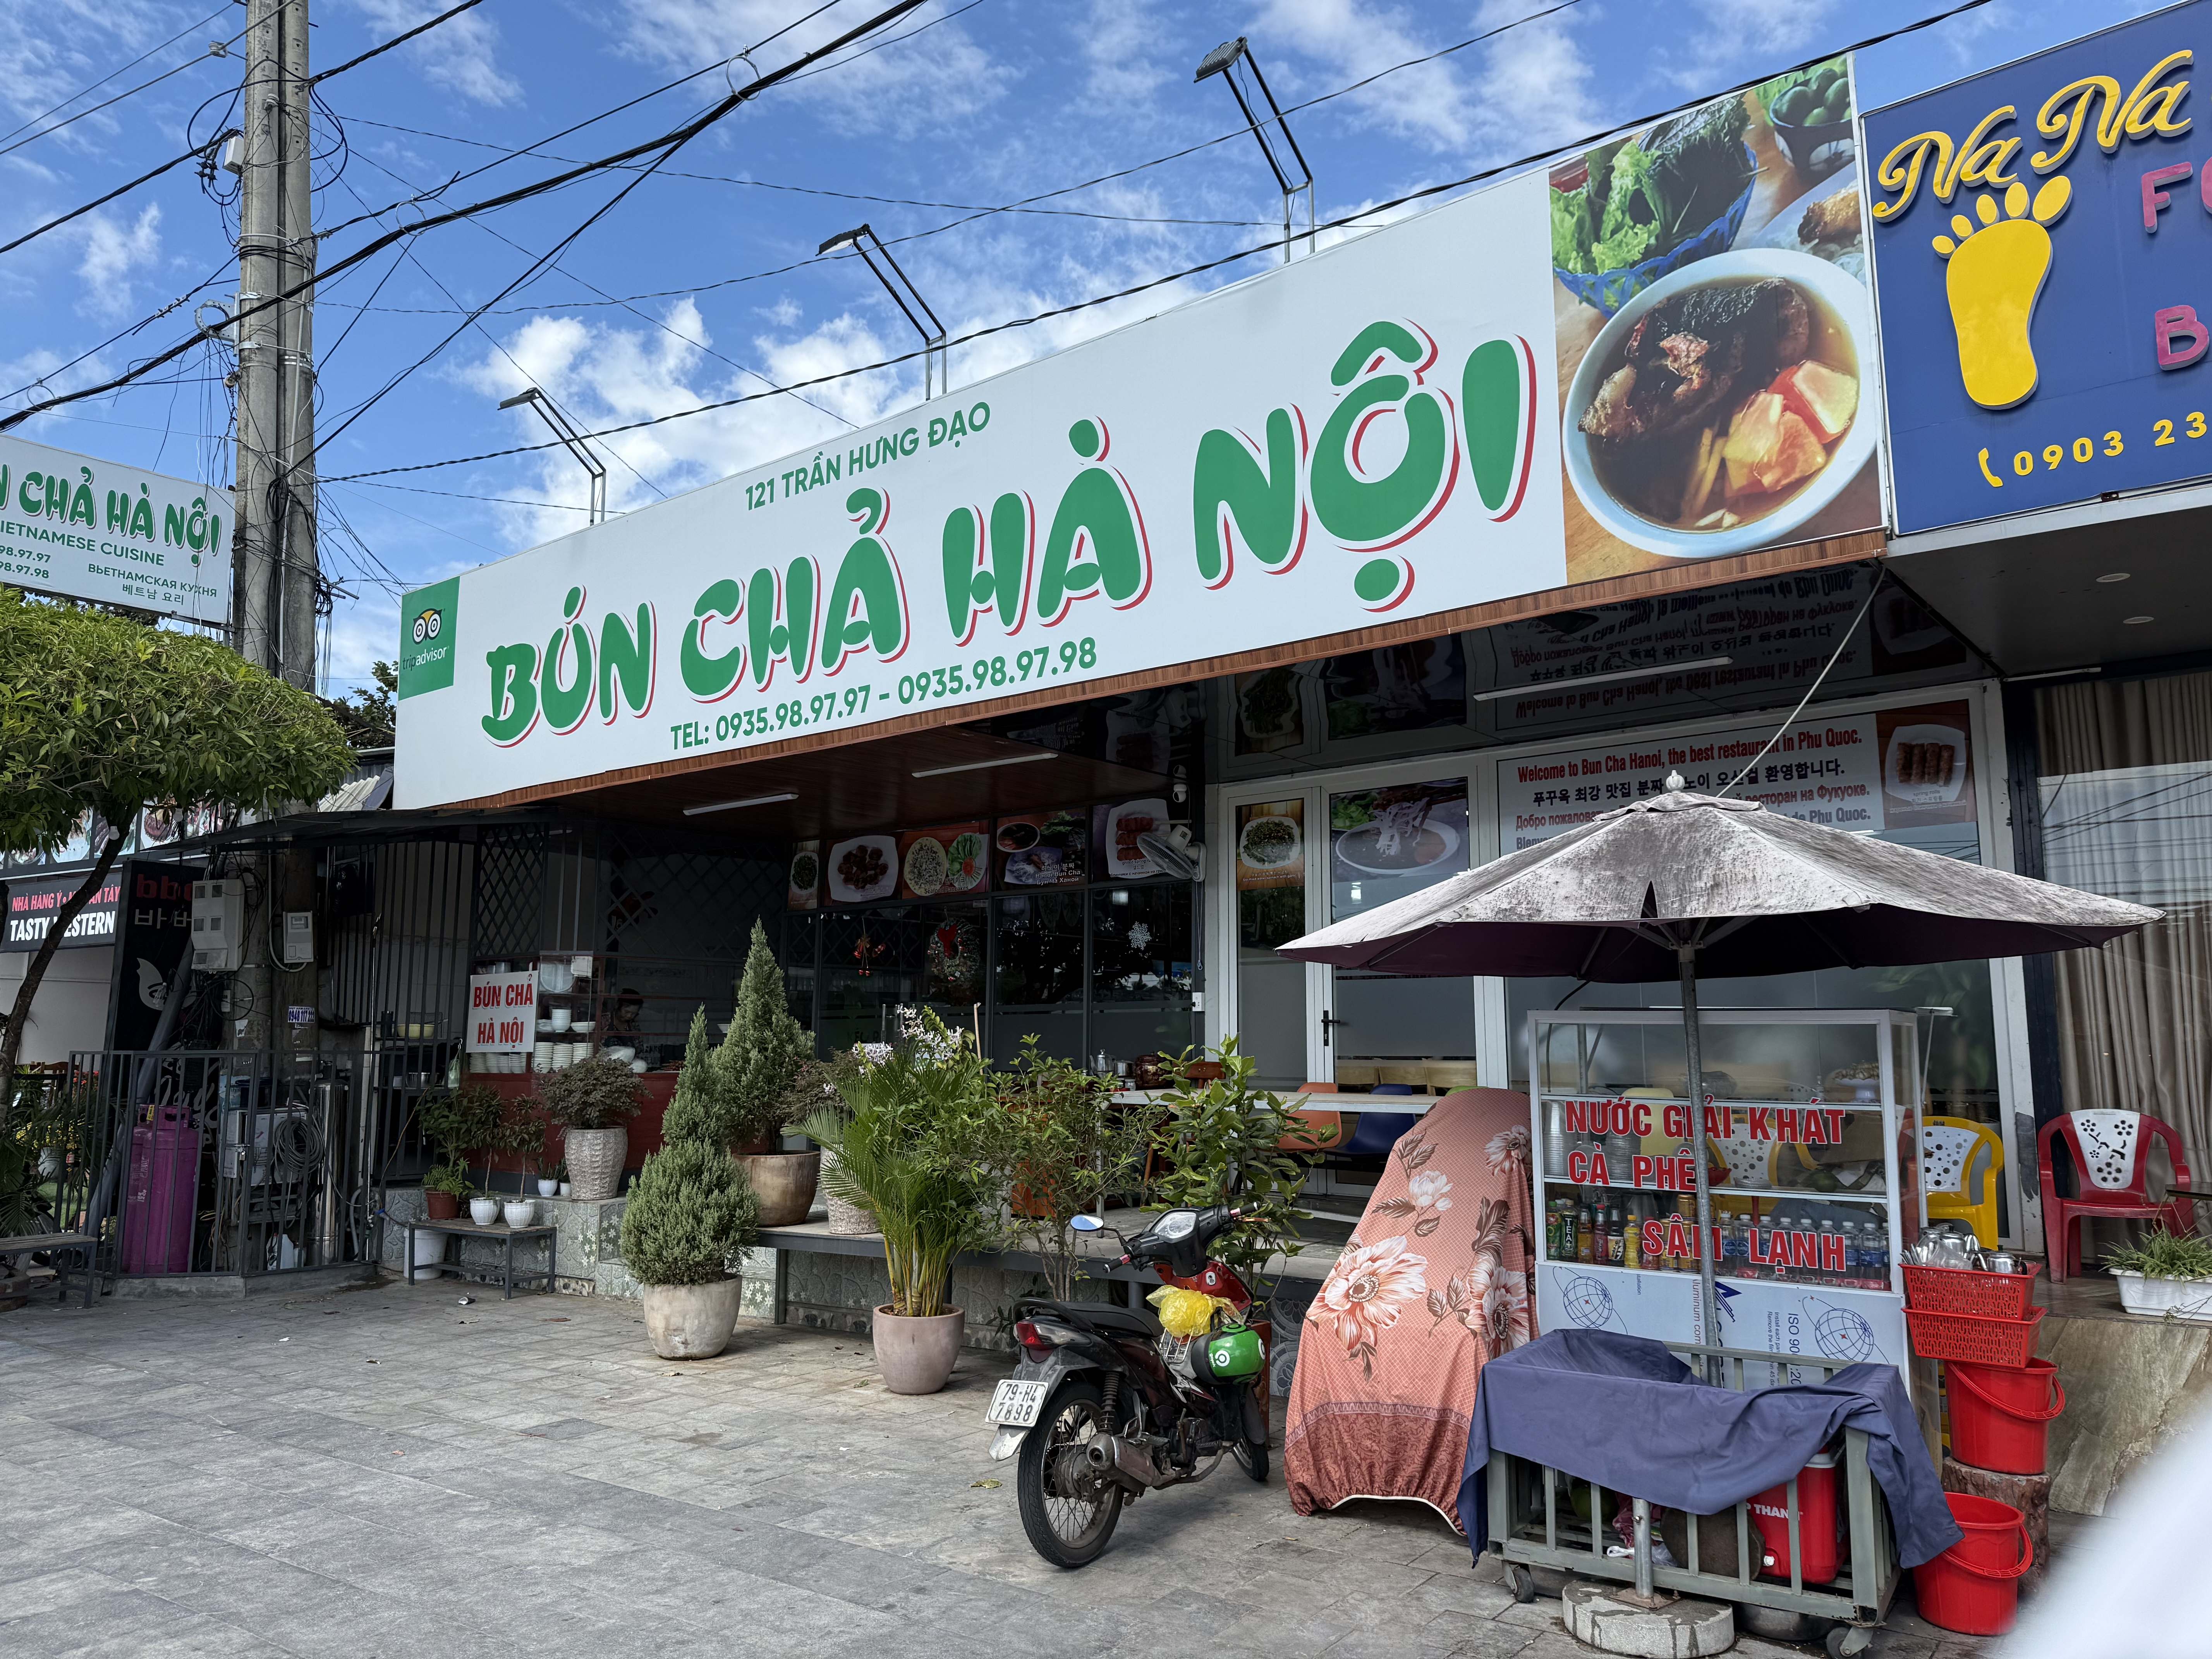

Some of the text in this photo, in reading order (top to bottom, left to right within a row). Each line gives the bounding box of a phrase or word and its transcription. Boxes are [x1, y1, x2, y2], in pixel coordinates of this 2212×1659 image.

[1873, 50, 2193, 223] Na Na
[2141, 156, 2212, 234] F
[745, 402, 990, 511] 121 TRẦN HƯNG ĐẠO
[2014, 412, 2207, 476] 0903 23
[19, 466, 96, 529] CHẢ
[107, 483, 155, 541] HÀ
[165, 497, 222, 567] NỘI
[481, 316, 1537, 748] BÚN CHẢ HÀ NỘI
[100, 542, 165, 566] CUISINE
[88, 563, 217, 597] ВЬЕТНАМСКАЯ КУХНЯ
[122, 584, 184, 605] 베트남 요리
[402, 646, 448, 671] tripadvisor
[670, 723, 709, 750] TEL:
[716, 684, 871, 742] 0935.98.97.97
[898, 637, 1097, 705] 0935.98.97.98
[1518, 764, 1566, 783] Welcome
[1568, 761, 1579, 777] to
[1582, 758, 1602, 775] Bun
[1605, 755, 1626, 773] Cha
[1630, 749, 1665, 769] Hanoi,
[1668, 748, 1686, 765] the
[1689, 743, 1715, 763] best
[1783, 734, 1795, 752] in
[1798, 731, 1822, 750] Phu
[1826, 728, 1862, 747] Quoc.
[1533, 788, 1571, 807] 푸꾸옥
[1575, 785, 1601, 802] 최강
[1606, 781, 1631, 800] 맛집
[1637, 778, 1664, 796] 분짜
[1683, 772, 1710, 790] 노이
[1765, 757, 1845, 783] 환영합니다.
[1516, 814, 1546, 831] Добро
[1801, 787, 1814, 801] на
[1817, 783, 1870, 802] Фукуоке.
[1810, 809, 1832, 823] Phu
[1836, 807, 1871, 822] Quoc.
[12, 893, 29, 912] NHÀ
[31, 891, 54, 910] HÀNG
[104, 884, 121, 903] TÂY
[10, 911, 115, 941] TASTY ESTERN
[473, 974, 533, 1008] BÚN CHẢ
[477, 1017, 524, 1048] HÀ NỘI
[1565, 1096, 1652, 1137] NƯỚC
[1748, 1097, 1845, 1144] KHÁT
[1568, 1142, 1697, 1192] CÀ PHÊ
[1749, 1228, 1846, 1274] LẠNH
[1788, 1313, 1799, 1335] ISO
[995, 1402, 1033, 1422] 7898
[1753, 1504, 1800, 1521] THÀN
